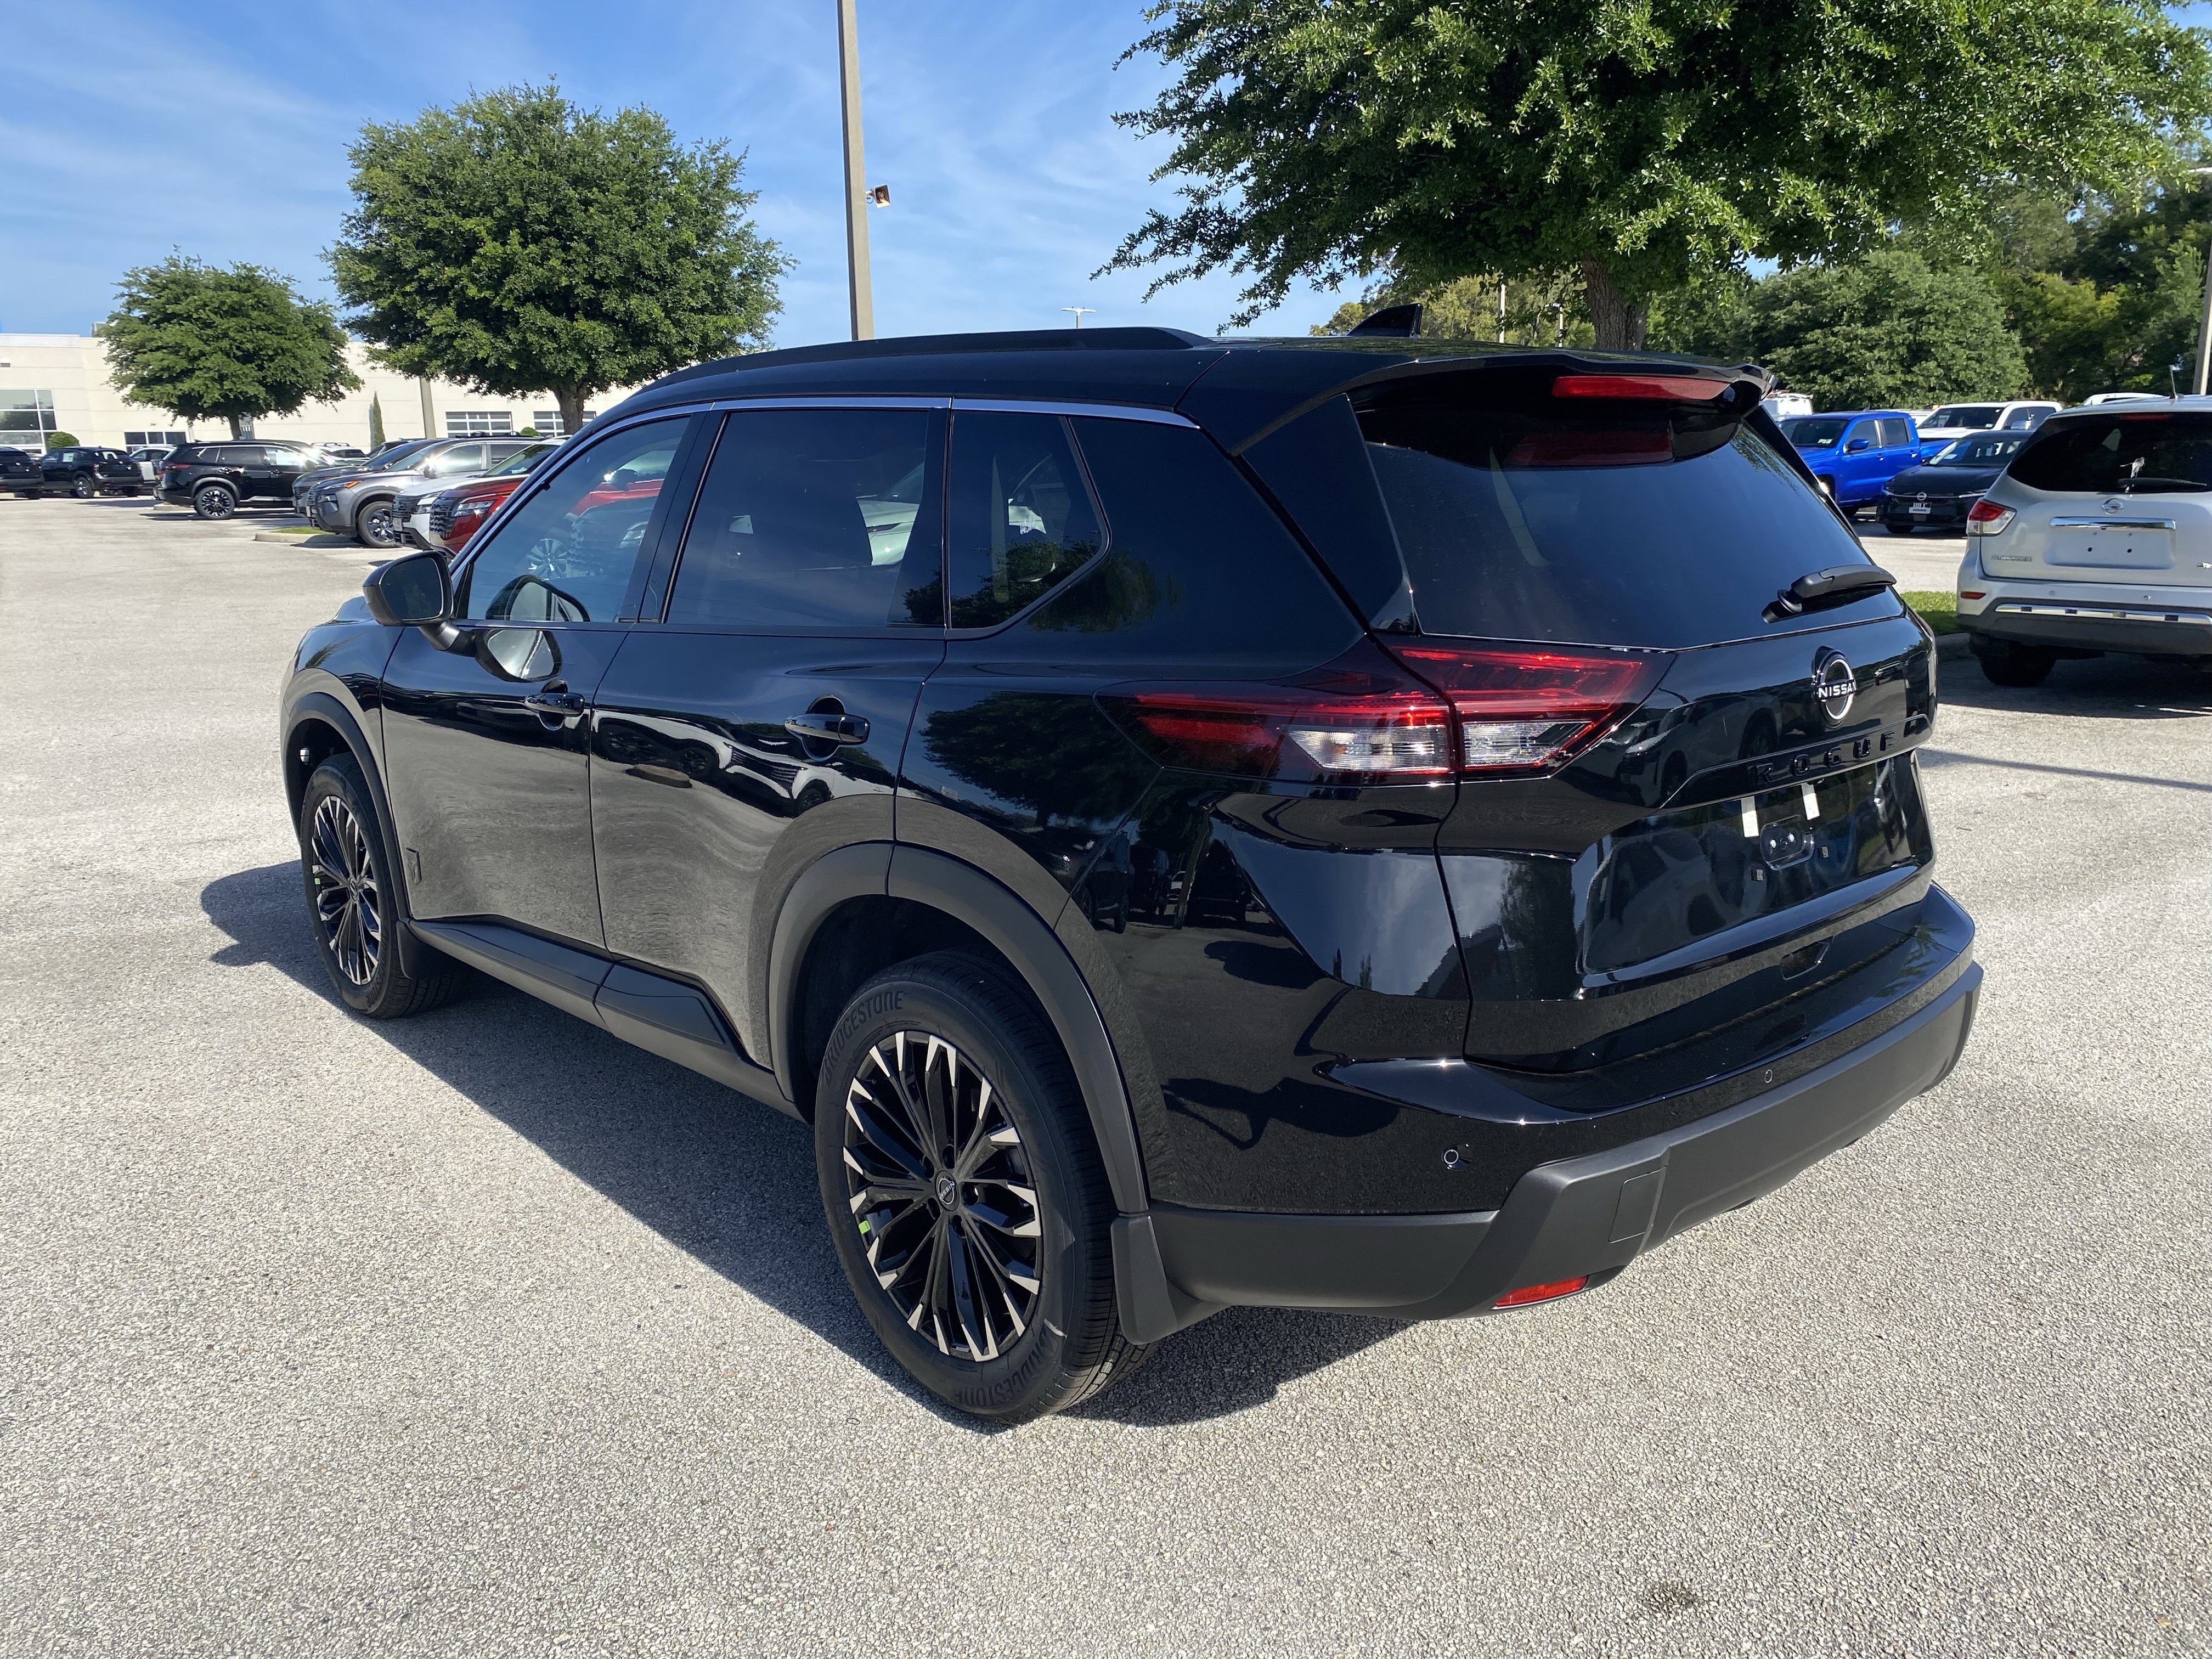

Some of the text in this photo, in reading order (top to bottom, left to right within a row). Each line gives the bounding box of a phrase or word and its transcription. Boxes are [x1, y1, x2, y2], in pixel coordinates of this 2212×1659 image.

[1818, 681, 1857, 698] NISSAN
[1756, 732, 1895, 785] ROGUE
[823, 990, 904, 1087] BRIDGESTONE
